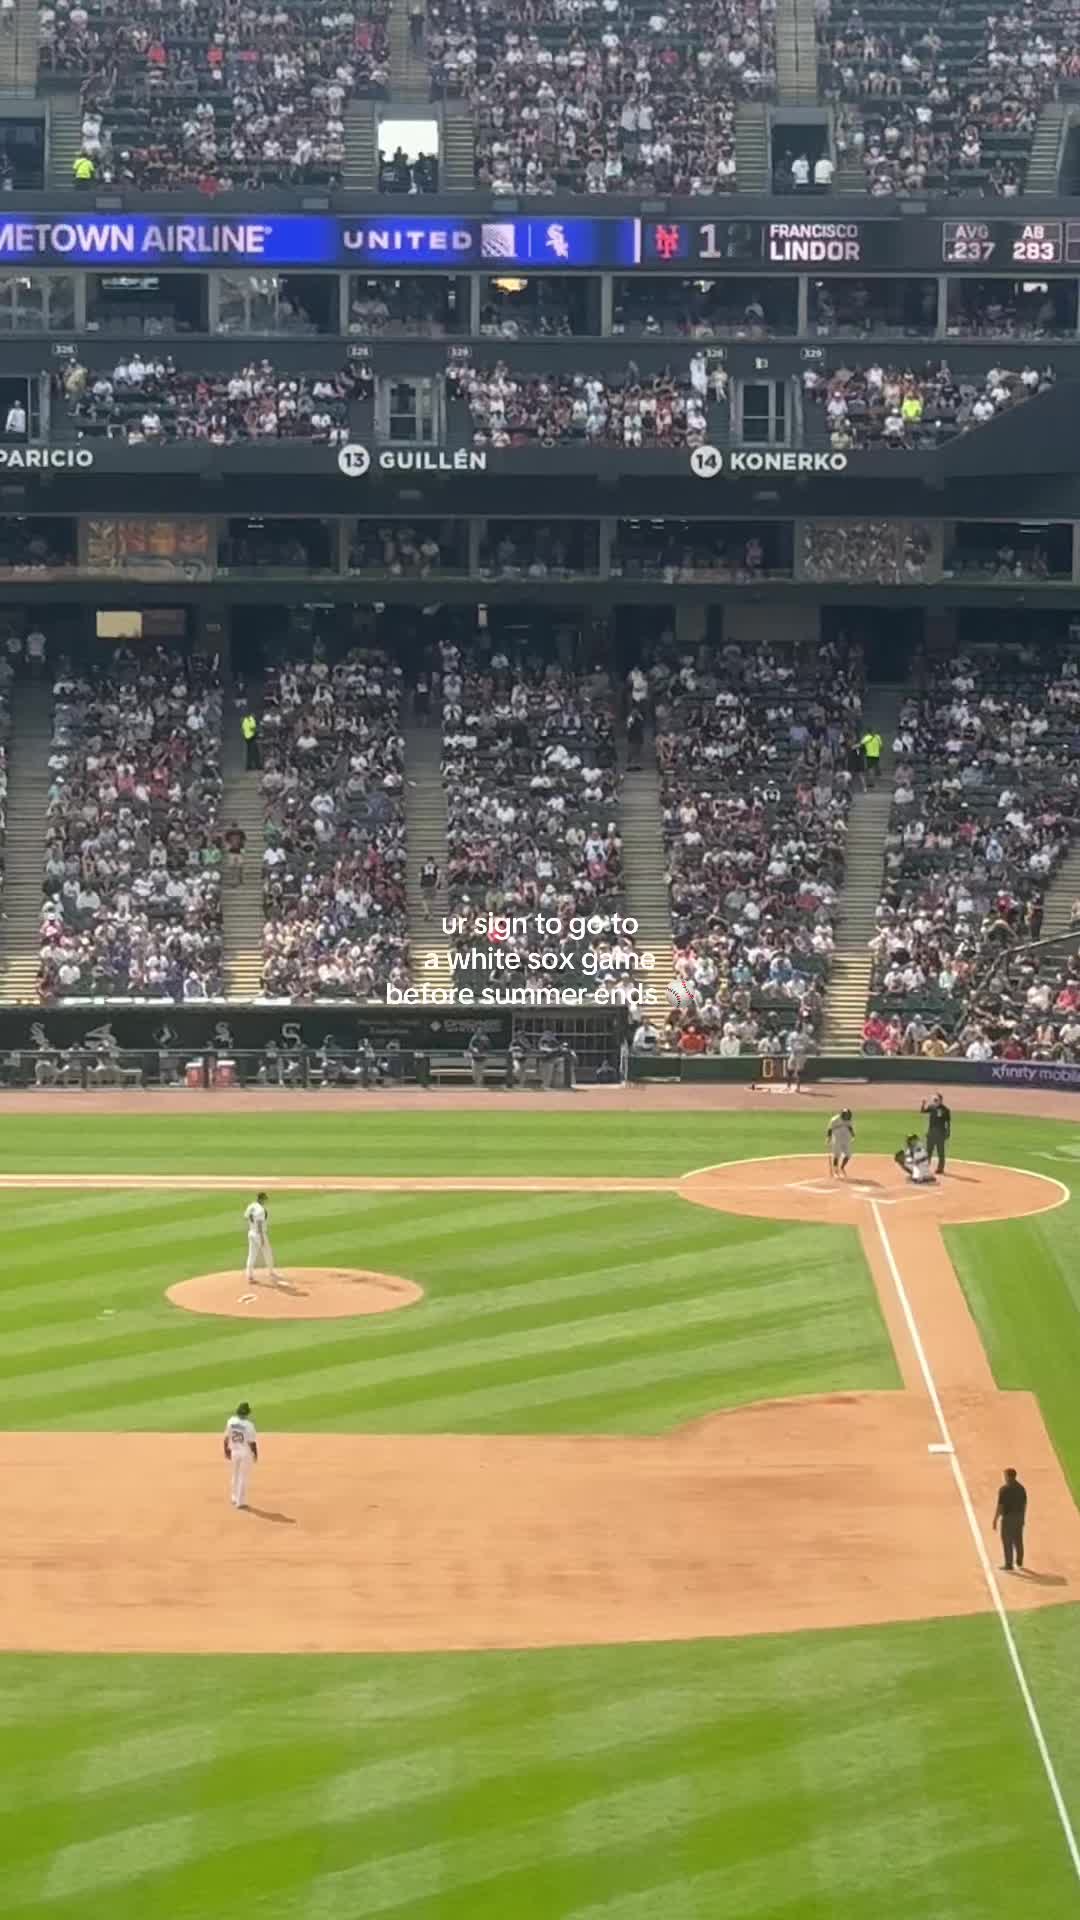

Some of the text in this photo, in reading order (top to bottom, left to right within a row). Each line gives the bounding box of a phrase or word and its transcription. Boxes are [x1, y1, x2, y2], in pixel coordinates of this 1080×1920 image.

[343, 230, 473, 250] UNITED
[769, 223, 858, 239] FRANCISCO
[955, 225, 989, 239] AVG
[1022, 225, 1045, 239] AB
[769, 240, 861, 262] LINDOR
[947, 242, 996, 260] .237
[1012, 242, 1055, 260] 283
[0, 449, 93, 468] PARICIO
[344, 448, 487, 470] 13 GUILLÉN
[696, 452, 848, 471] 14 KONERKO
[991, 1064, 1036, 1081] xfinity
